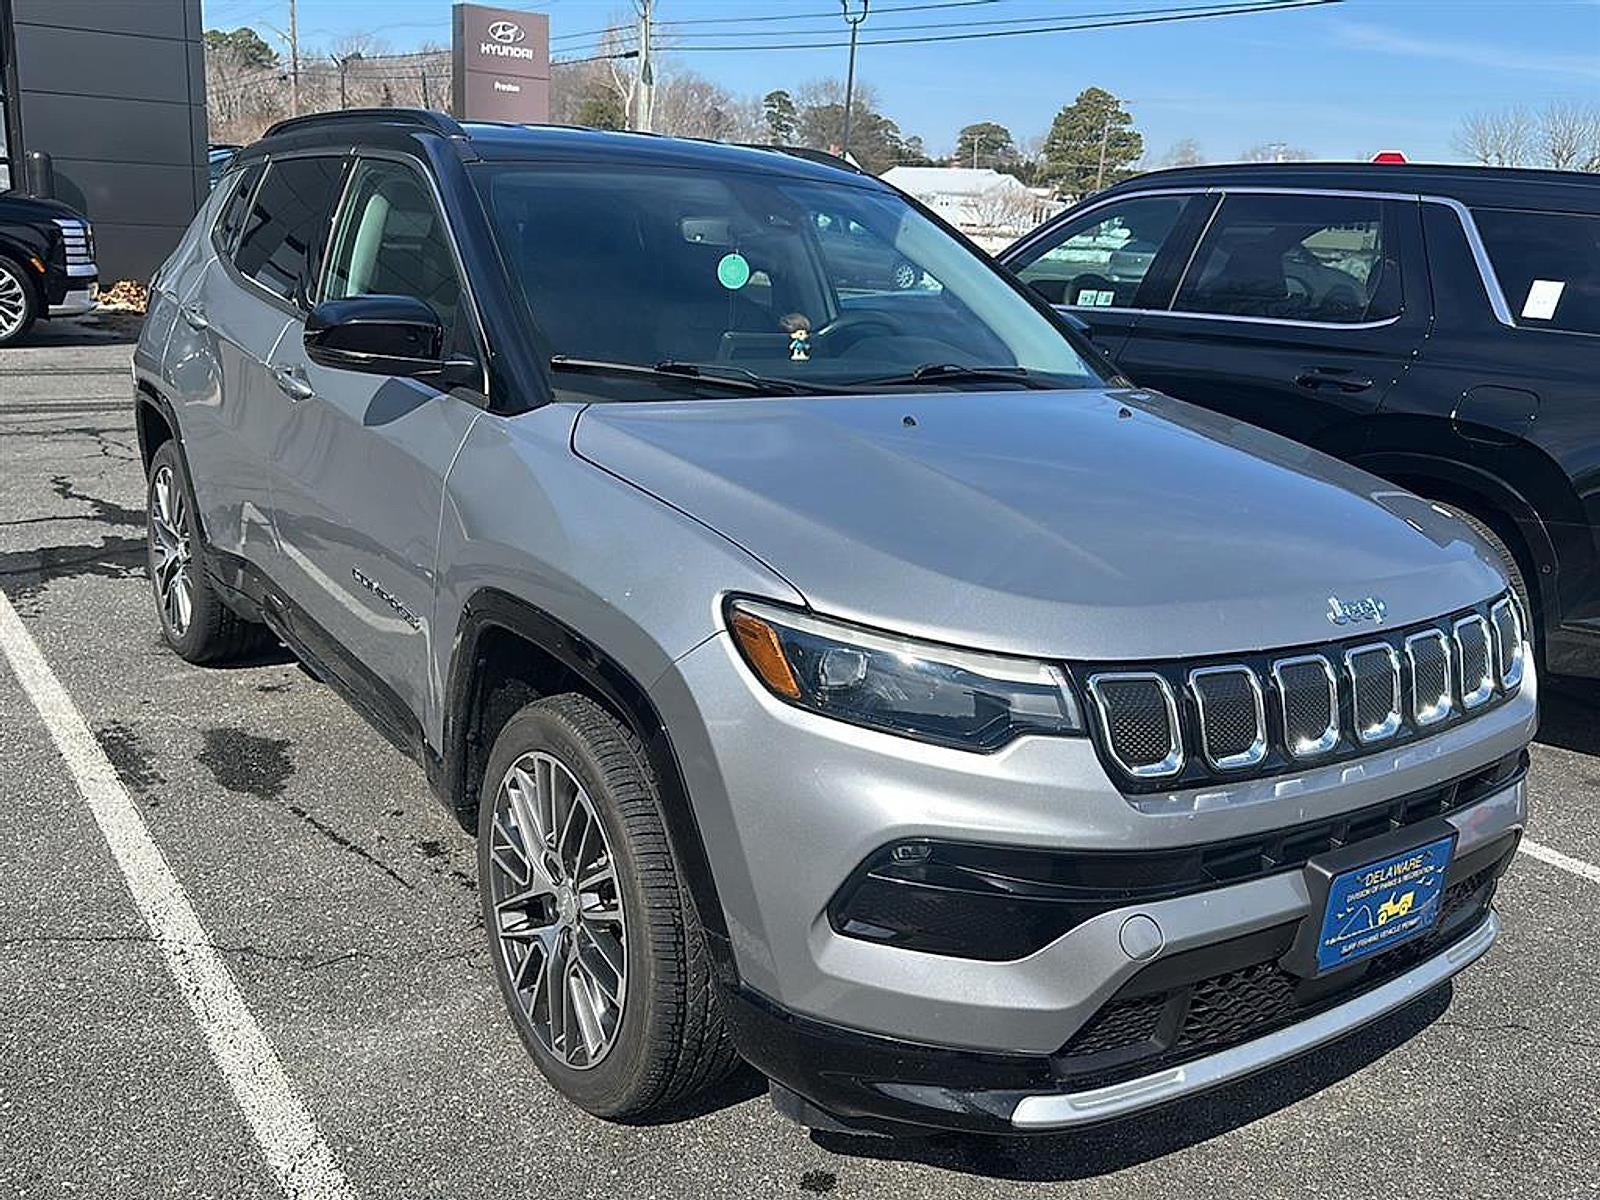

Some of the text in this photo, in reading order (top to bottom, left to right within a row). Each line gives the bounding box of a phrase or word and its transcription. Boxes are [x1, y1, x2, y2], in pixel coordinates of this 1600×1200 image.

[480, 42, 533, 60] HYUNDAI
[1326, 596, 1386, 624] Jeep
[1363, 854, 1424, 887] DELAWARE
